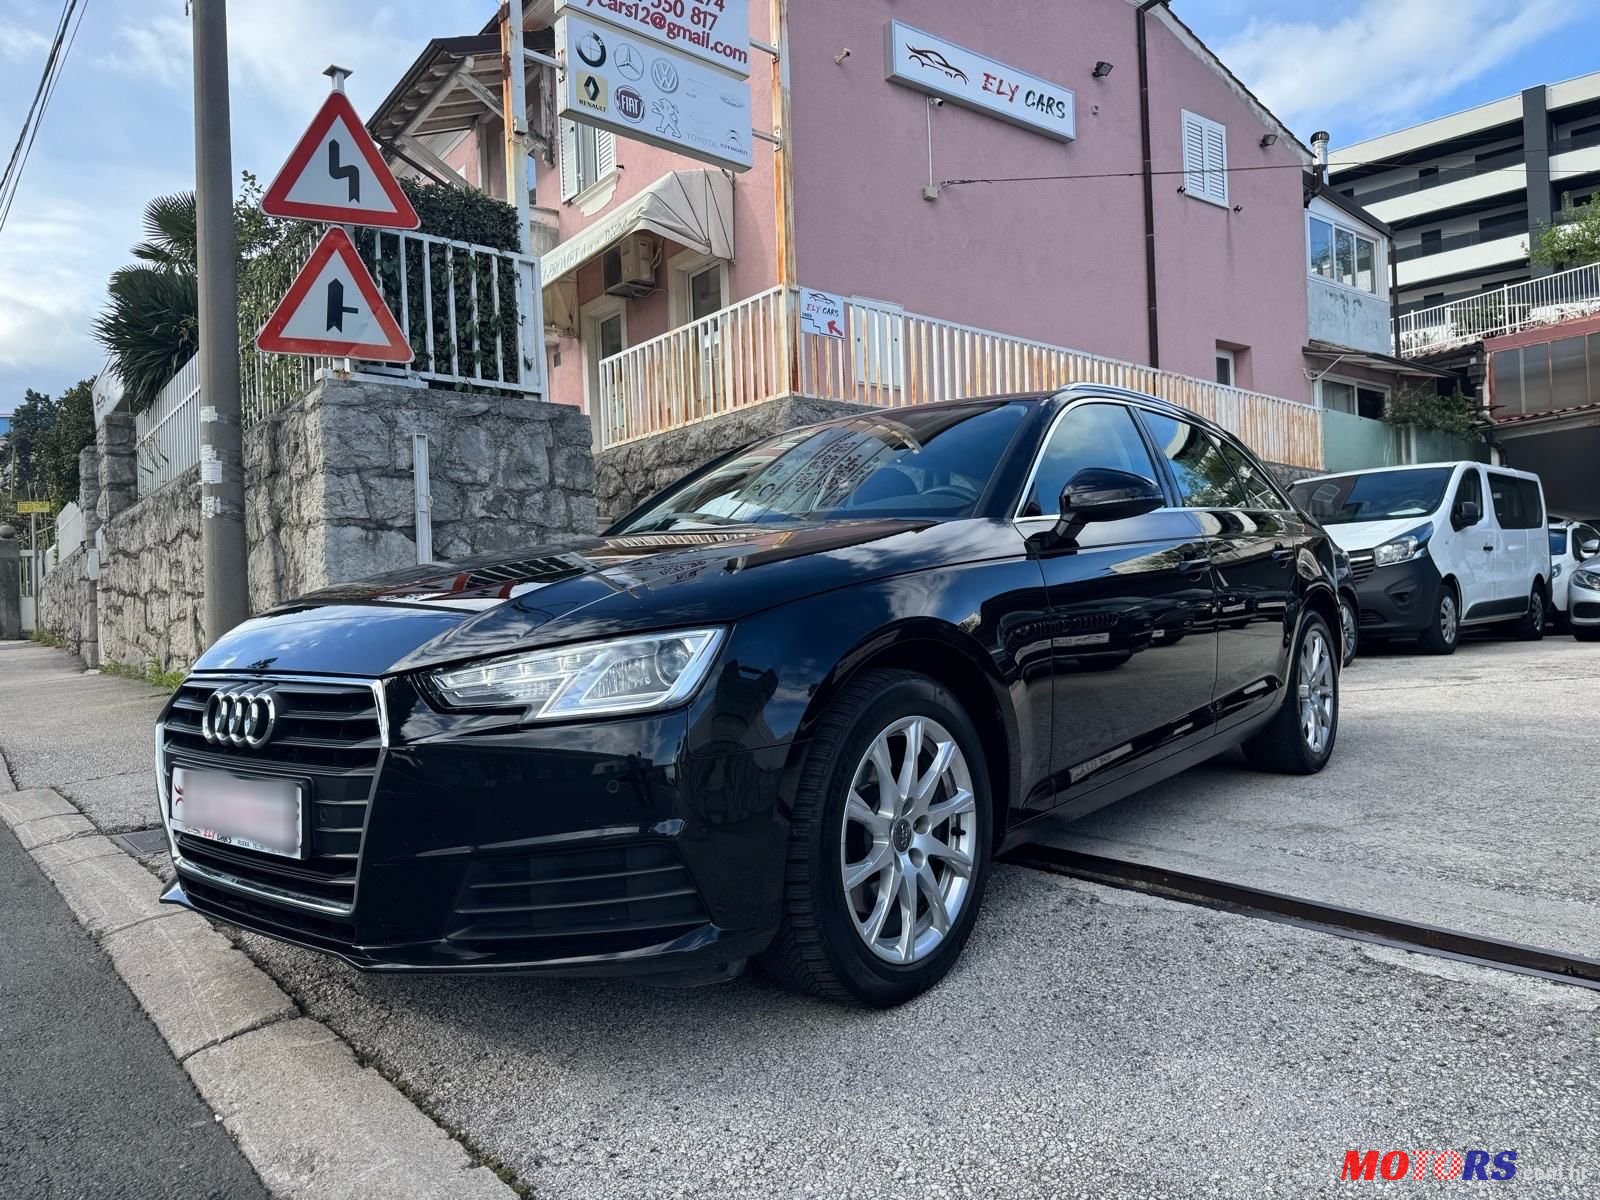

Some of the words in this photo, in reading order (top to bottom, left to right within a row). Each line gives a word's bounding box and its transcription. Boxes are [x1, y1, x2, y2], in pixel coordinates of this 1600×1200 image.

[690, 6, 718, 31] 817
[621, 94, 639, 114] FIAT
[982, 72, 1019, 103] ELY
[1024, 89, 1066, 119] CARS
[578, 98, 607, 112] RENAULT
[686, 132, 718, 149] TOYOTA
[806, 303, 821, 314] ELY
[822, 307, 840, 318] CARS
